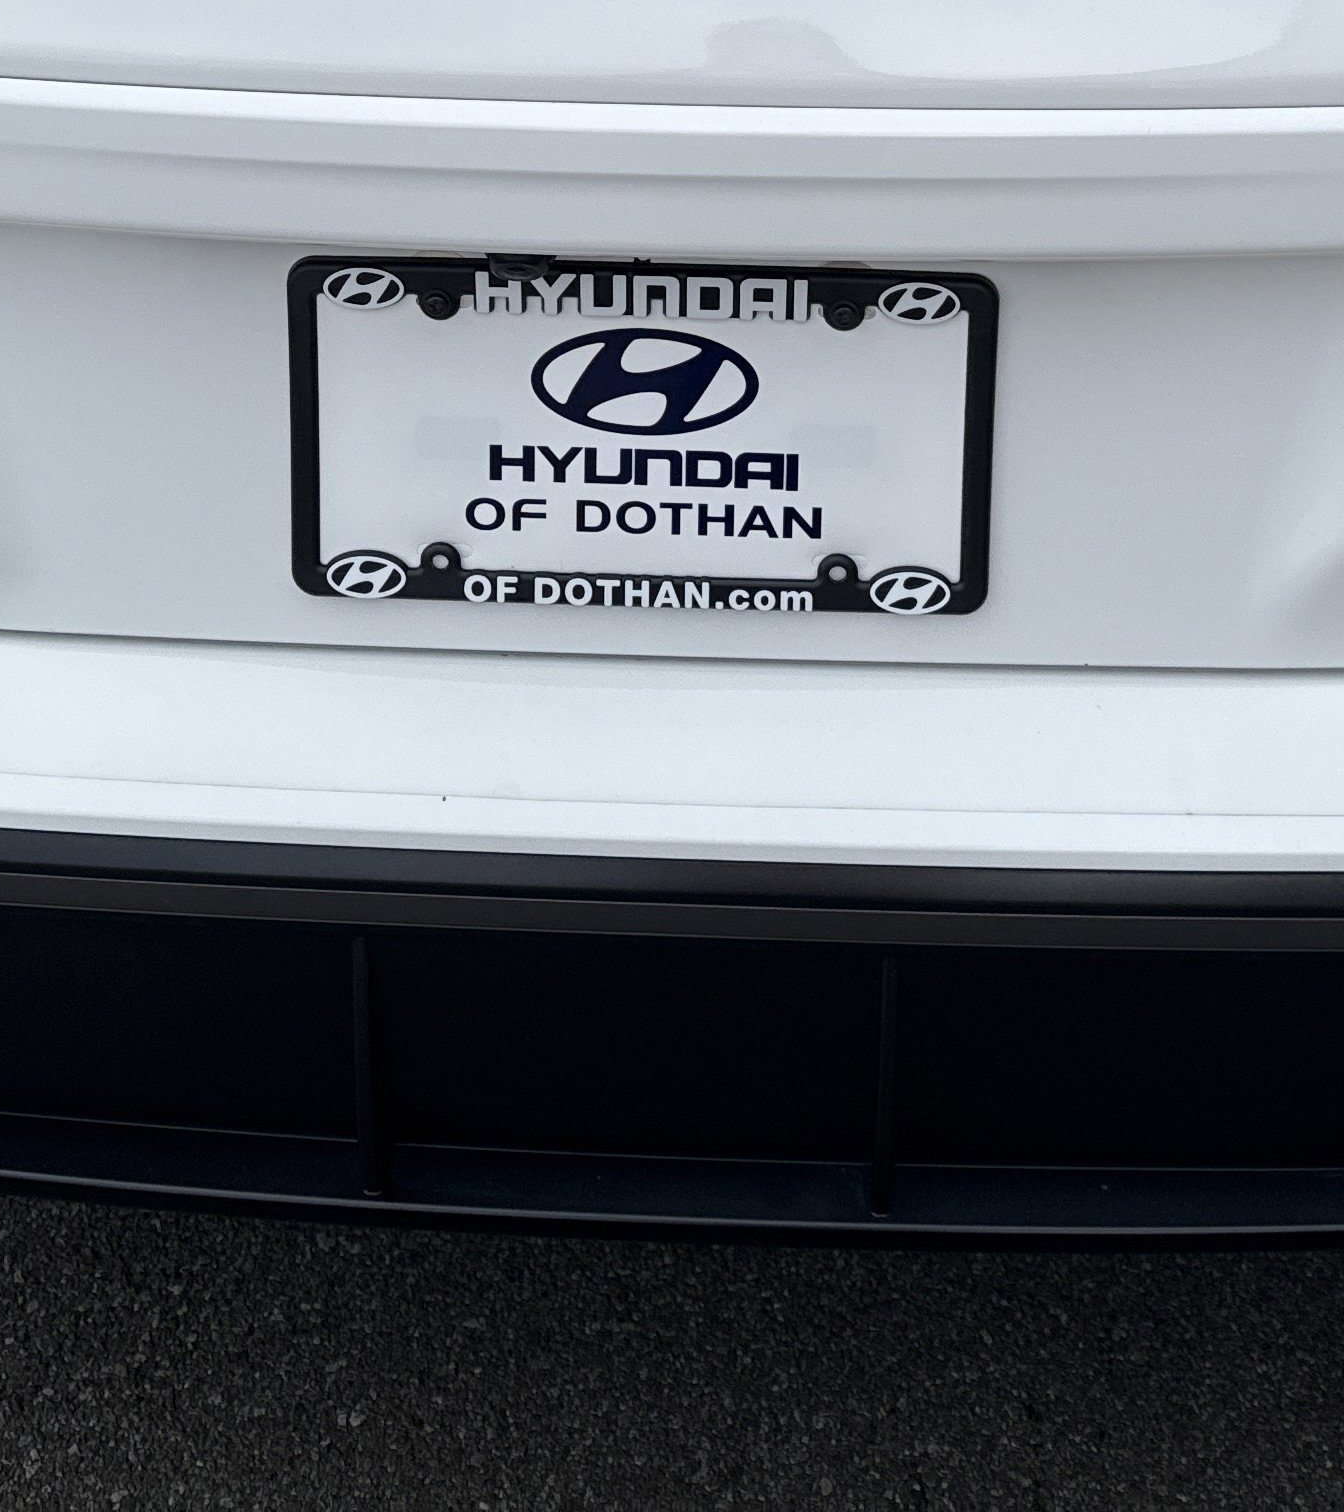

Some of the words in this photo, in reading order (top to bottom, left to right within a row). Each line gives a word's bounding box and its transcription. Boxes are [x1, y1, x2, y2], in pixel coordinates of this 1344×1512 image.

[474, 270, 812, 322] HYUNDAI
[488, 444, 799, 491] HYUNDAI
[464, 497, 548, 533] OF
[575, 500, 823, 540] DOTHAN
[463, 575, 519, 603] OF
[534, 577, 814, 612] DOTHAN.com
